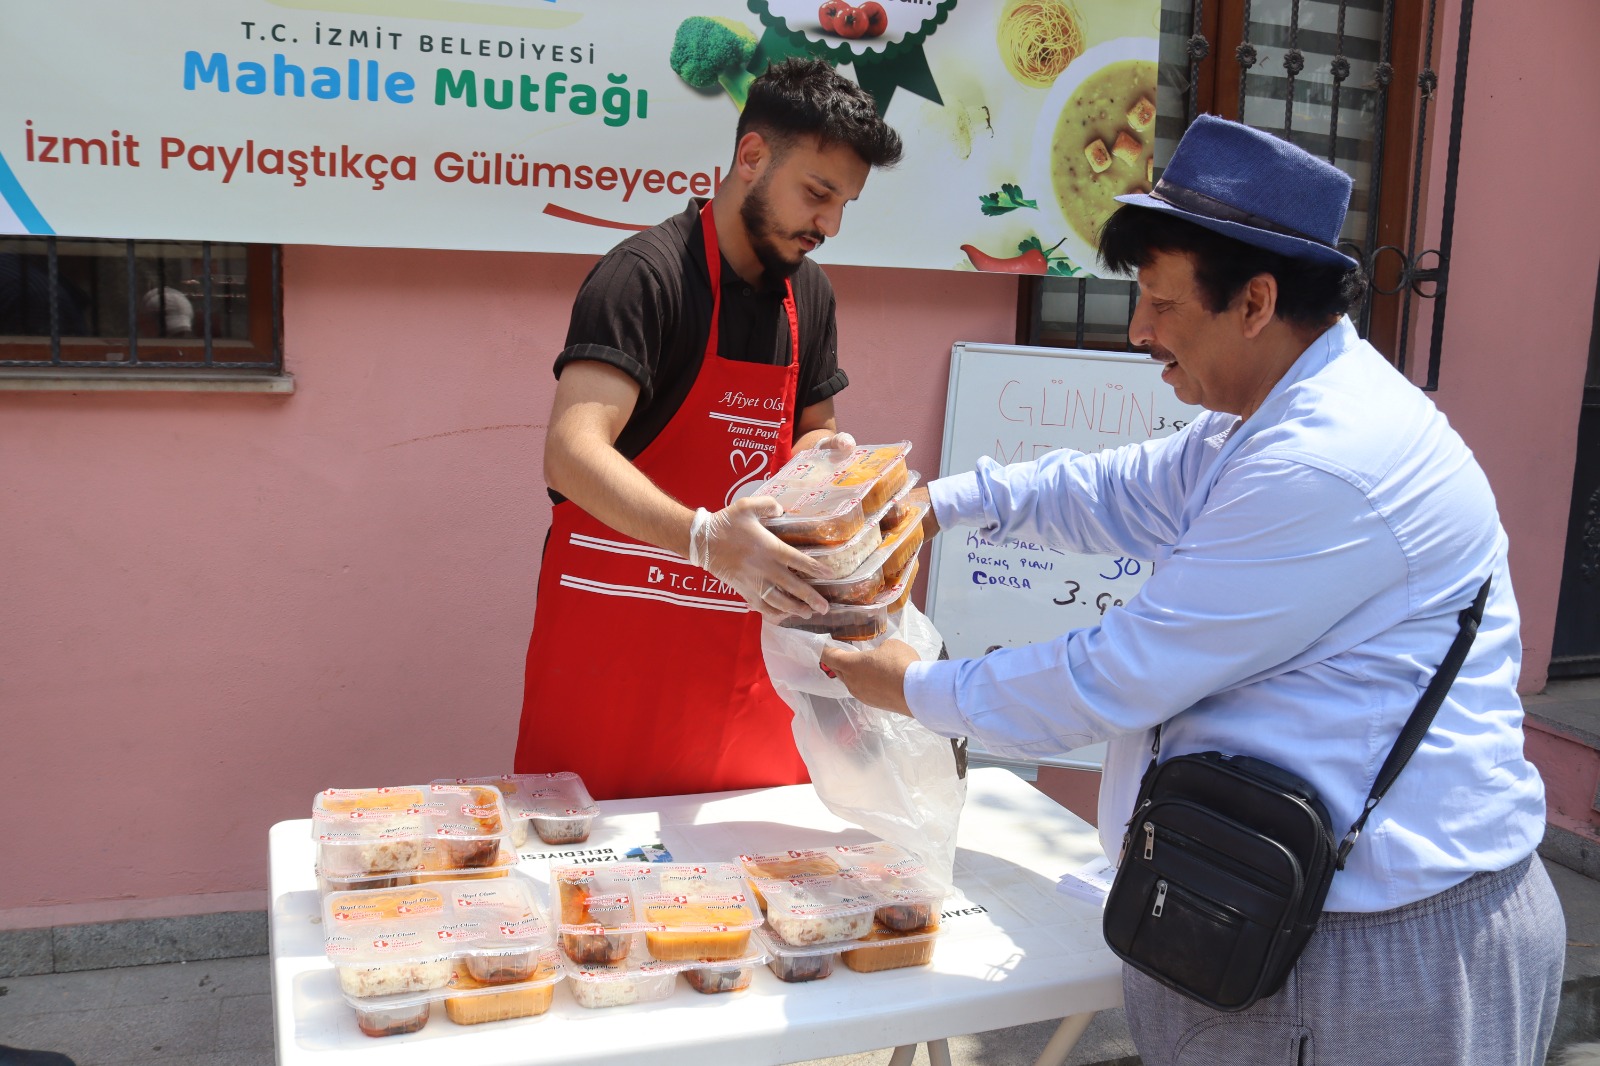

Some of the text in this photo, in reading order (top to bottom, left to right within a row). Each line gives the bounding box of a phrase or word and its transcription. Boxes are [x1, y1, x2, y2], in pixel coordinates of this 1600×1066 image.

[241, 21, 596, 65] T.C. İZMİT BELEDİYESİ
[183, 50, 649, 128] Mahalle Mutfağı
[25, 119, 140, 168] İzmit
[160, 135, 417, 191] Paylaştıkça
[718, 391, 760, 409] Afiyet
[999, 379, 1154, 438] GÜNÜN
[727, 422, 754, 435] İzmit
[669, 572, 697, 591] T.C.
